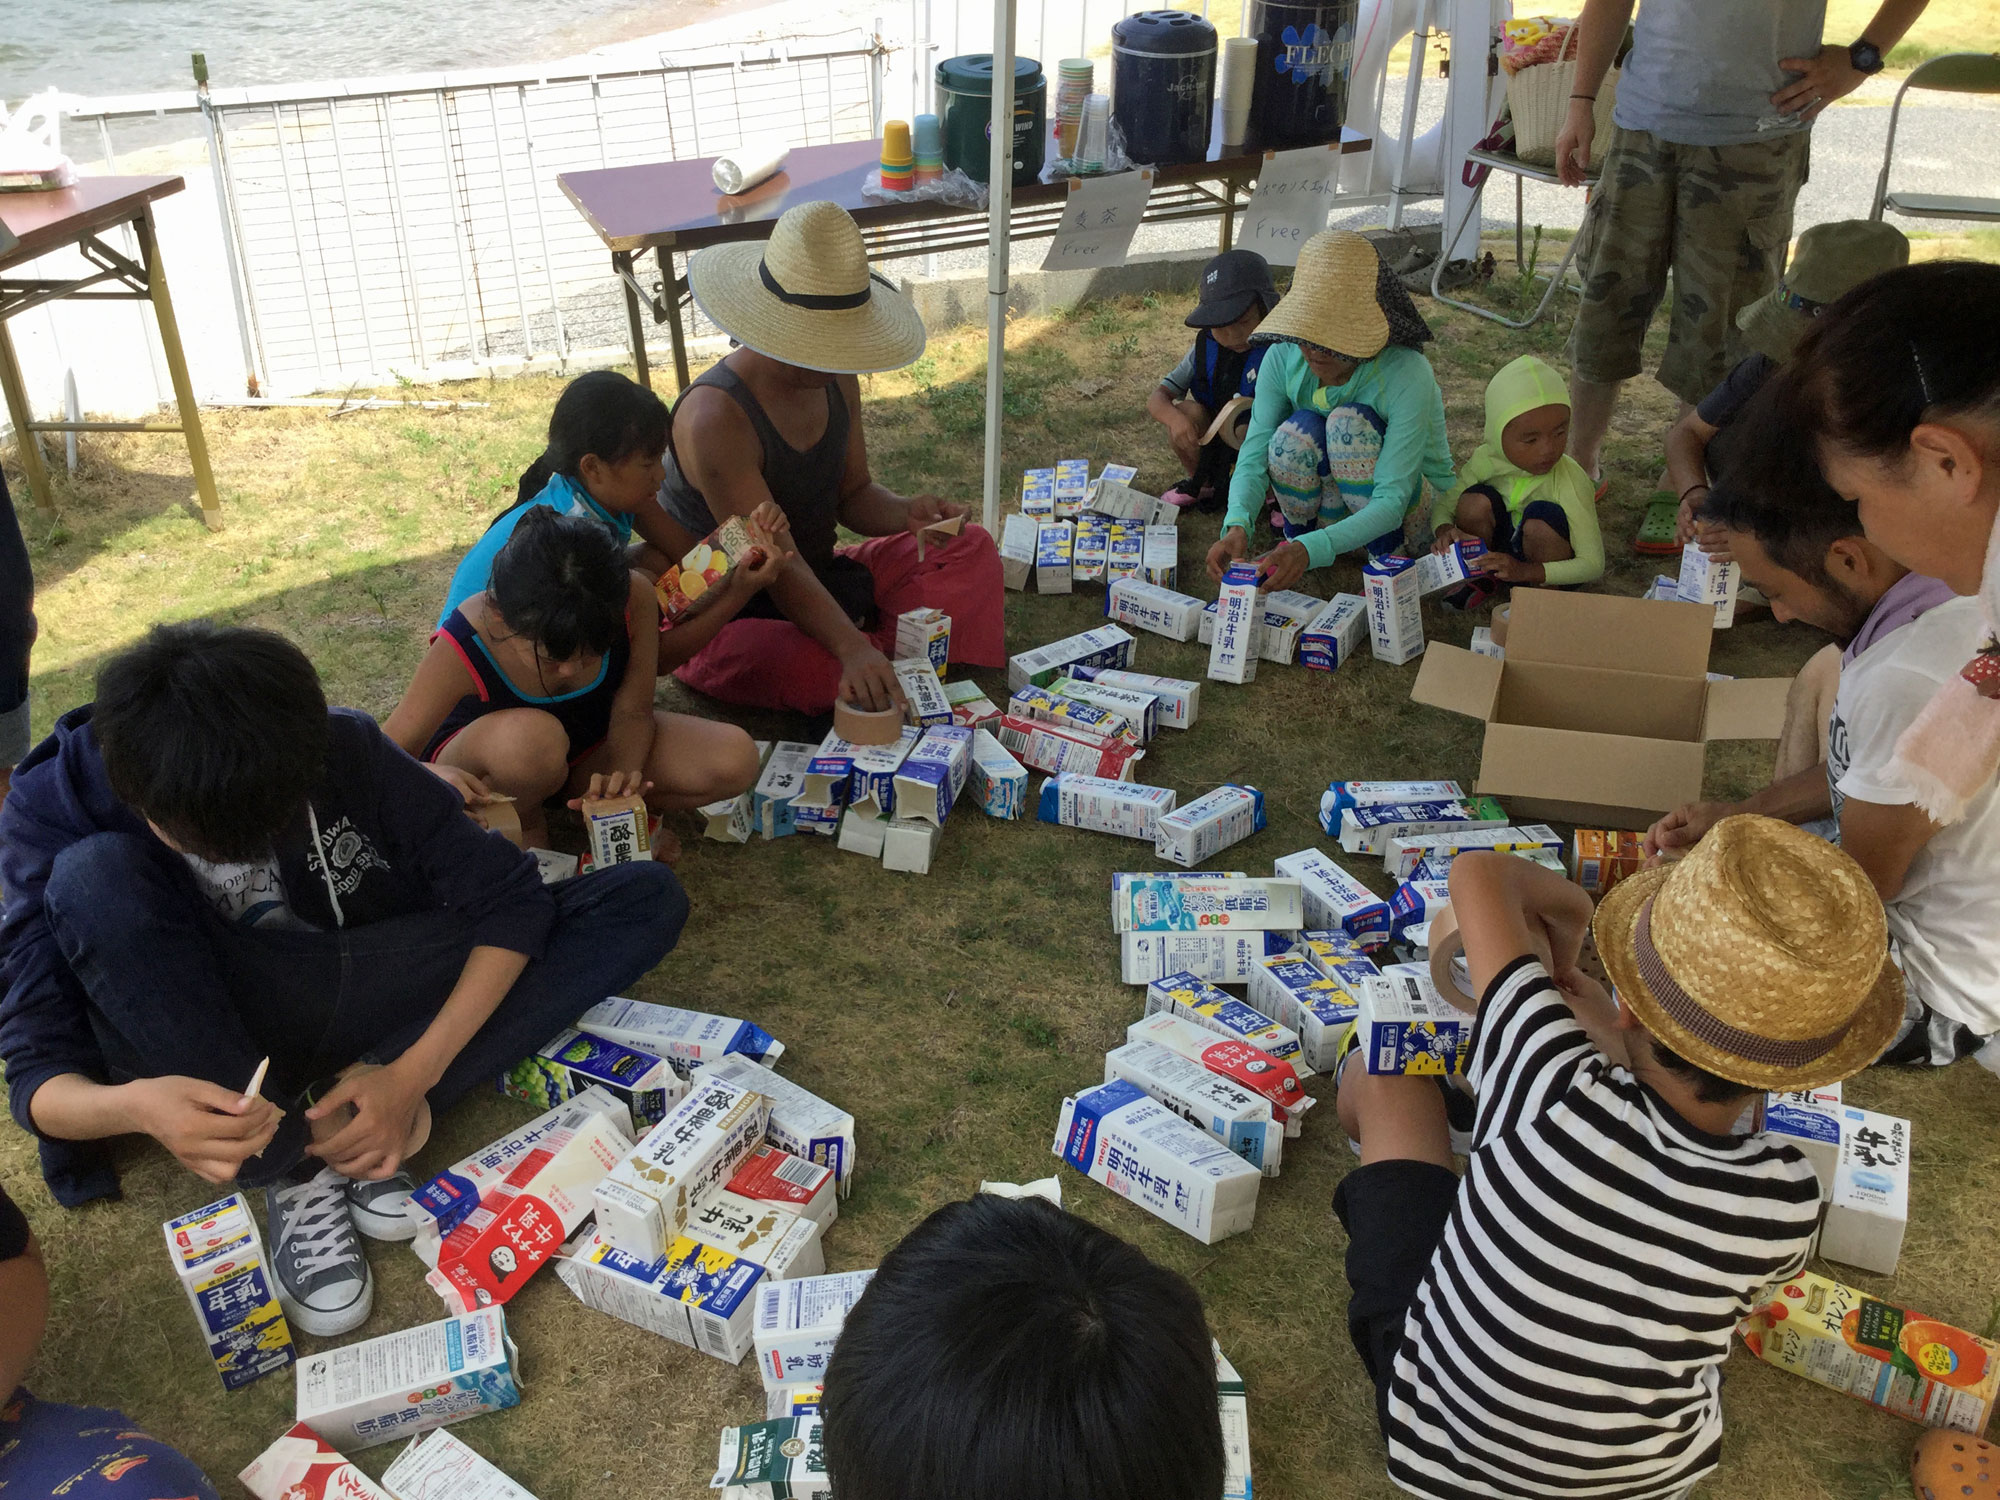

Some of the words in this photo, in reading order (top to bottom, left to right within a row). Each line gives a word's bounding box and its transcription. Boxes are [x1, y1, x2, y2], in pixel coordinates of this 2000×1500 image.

[1256, 217, 1300, 241] Free
[1228, 588, 1246, 597] meiji
[1118, 598, 1162, 623] 明治牛乳
[1223, 597, 1243, 651] 明治牛乳
[1371, 586, 1388, 635] 明治牛乳
[1312, 867, 1360, 904] 明治牛乳
[1224, 894, 1270, 912] 低脂肪
[1236, 938, 1247, 977] 明治牛乳
[1207, 1042, 1241, 1063] 牛乳
[653, 1089, 737, 1167] 酪農牛乳
[1125, 1107, 1165, 1127] 明治牛乳
[480, 1115, 561, 1169] 明治牛乳
[1071, 1117, 1089, 1157] 明治牛乳
[1097, 1137, 1109, 1166] meiji
[1853, 1127, 1897, 1167] 牛乳
[463, 1162, 485, 1178] meiji
[1106, 1145, 1171, 1200] 明治牛乳
[425, 1182, 452, 1206] 明治牛乳
[624, 1198, 649, 1216] 1000ml
[176, 1200, 230, 1225] コープ牛乳
[518, 1202, 554, 1244] 牛乳
[699, 1204, 755, 1235] 牛乳
[192, 1239, 246, 1266] コープ牛乳
[501, 1217, 544, 1262] チチヤス
[206, 1271, 255, 1298] コープ
[457, 1262, 479, 1288] 牛乳
[208, 1286, 263, 1312] 牛乳
[1821, 1283, 1854, 1335] オレンジ
[464, 1323, 479, 1358] 低脂肪
[1781, 1327, 1801, 1365] オレンジ
[354, 1407, 421, 1436] 低脂肪
